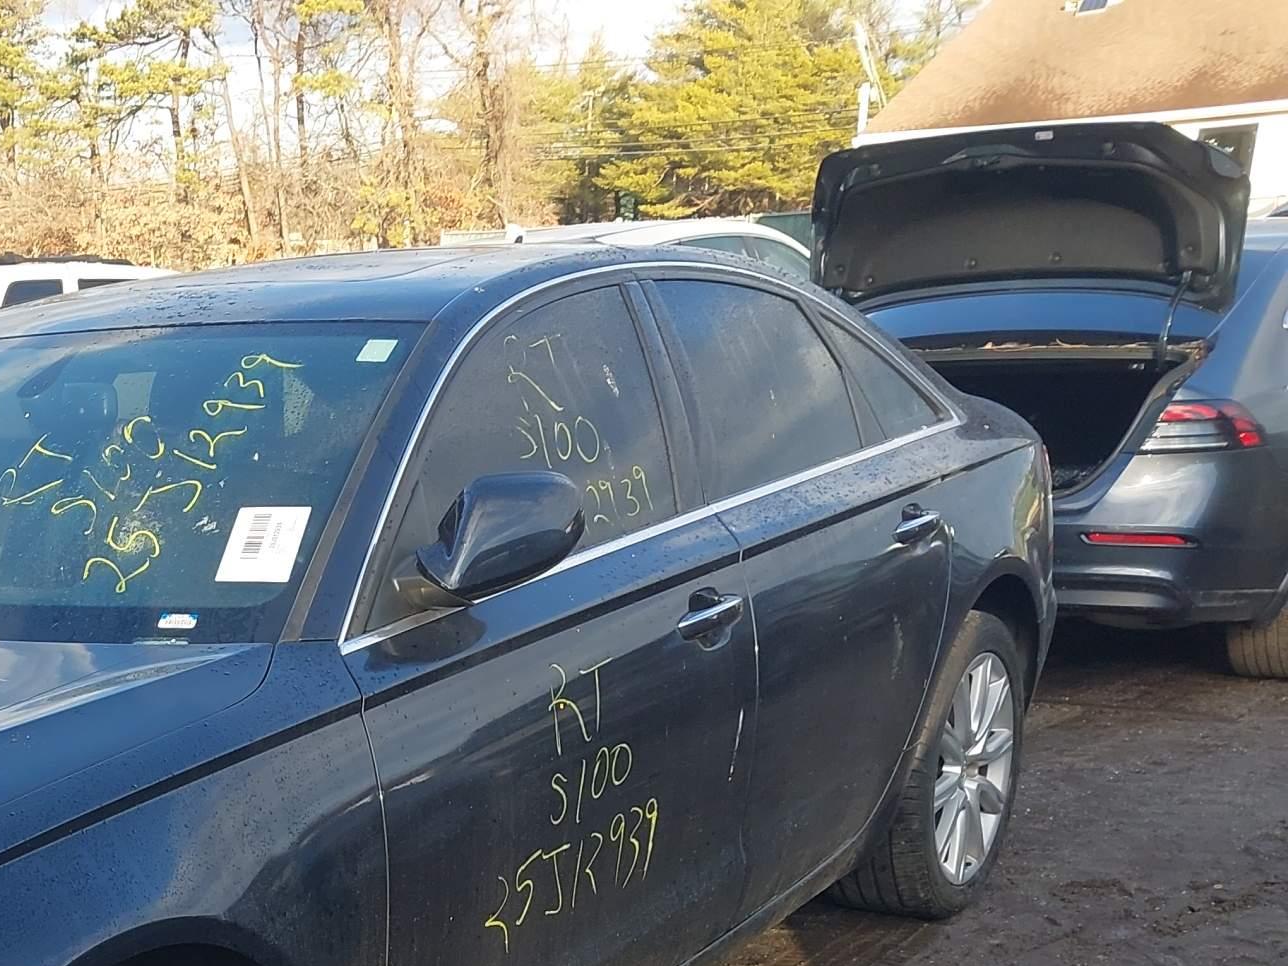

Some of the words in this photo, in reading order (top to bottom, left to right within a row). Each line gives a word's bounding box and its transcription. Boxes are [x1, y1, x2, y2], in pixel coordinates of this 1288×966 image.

[82, 352, 304, 593] 25J12939
[547, 656, 614, 756] RT
[550, 743, 633, 825] S100
[484, 797, 659, 954] 25J12939
